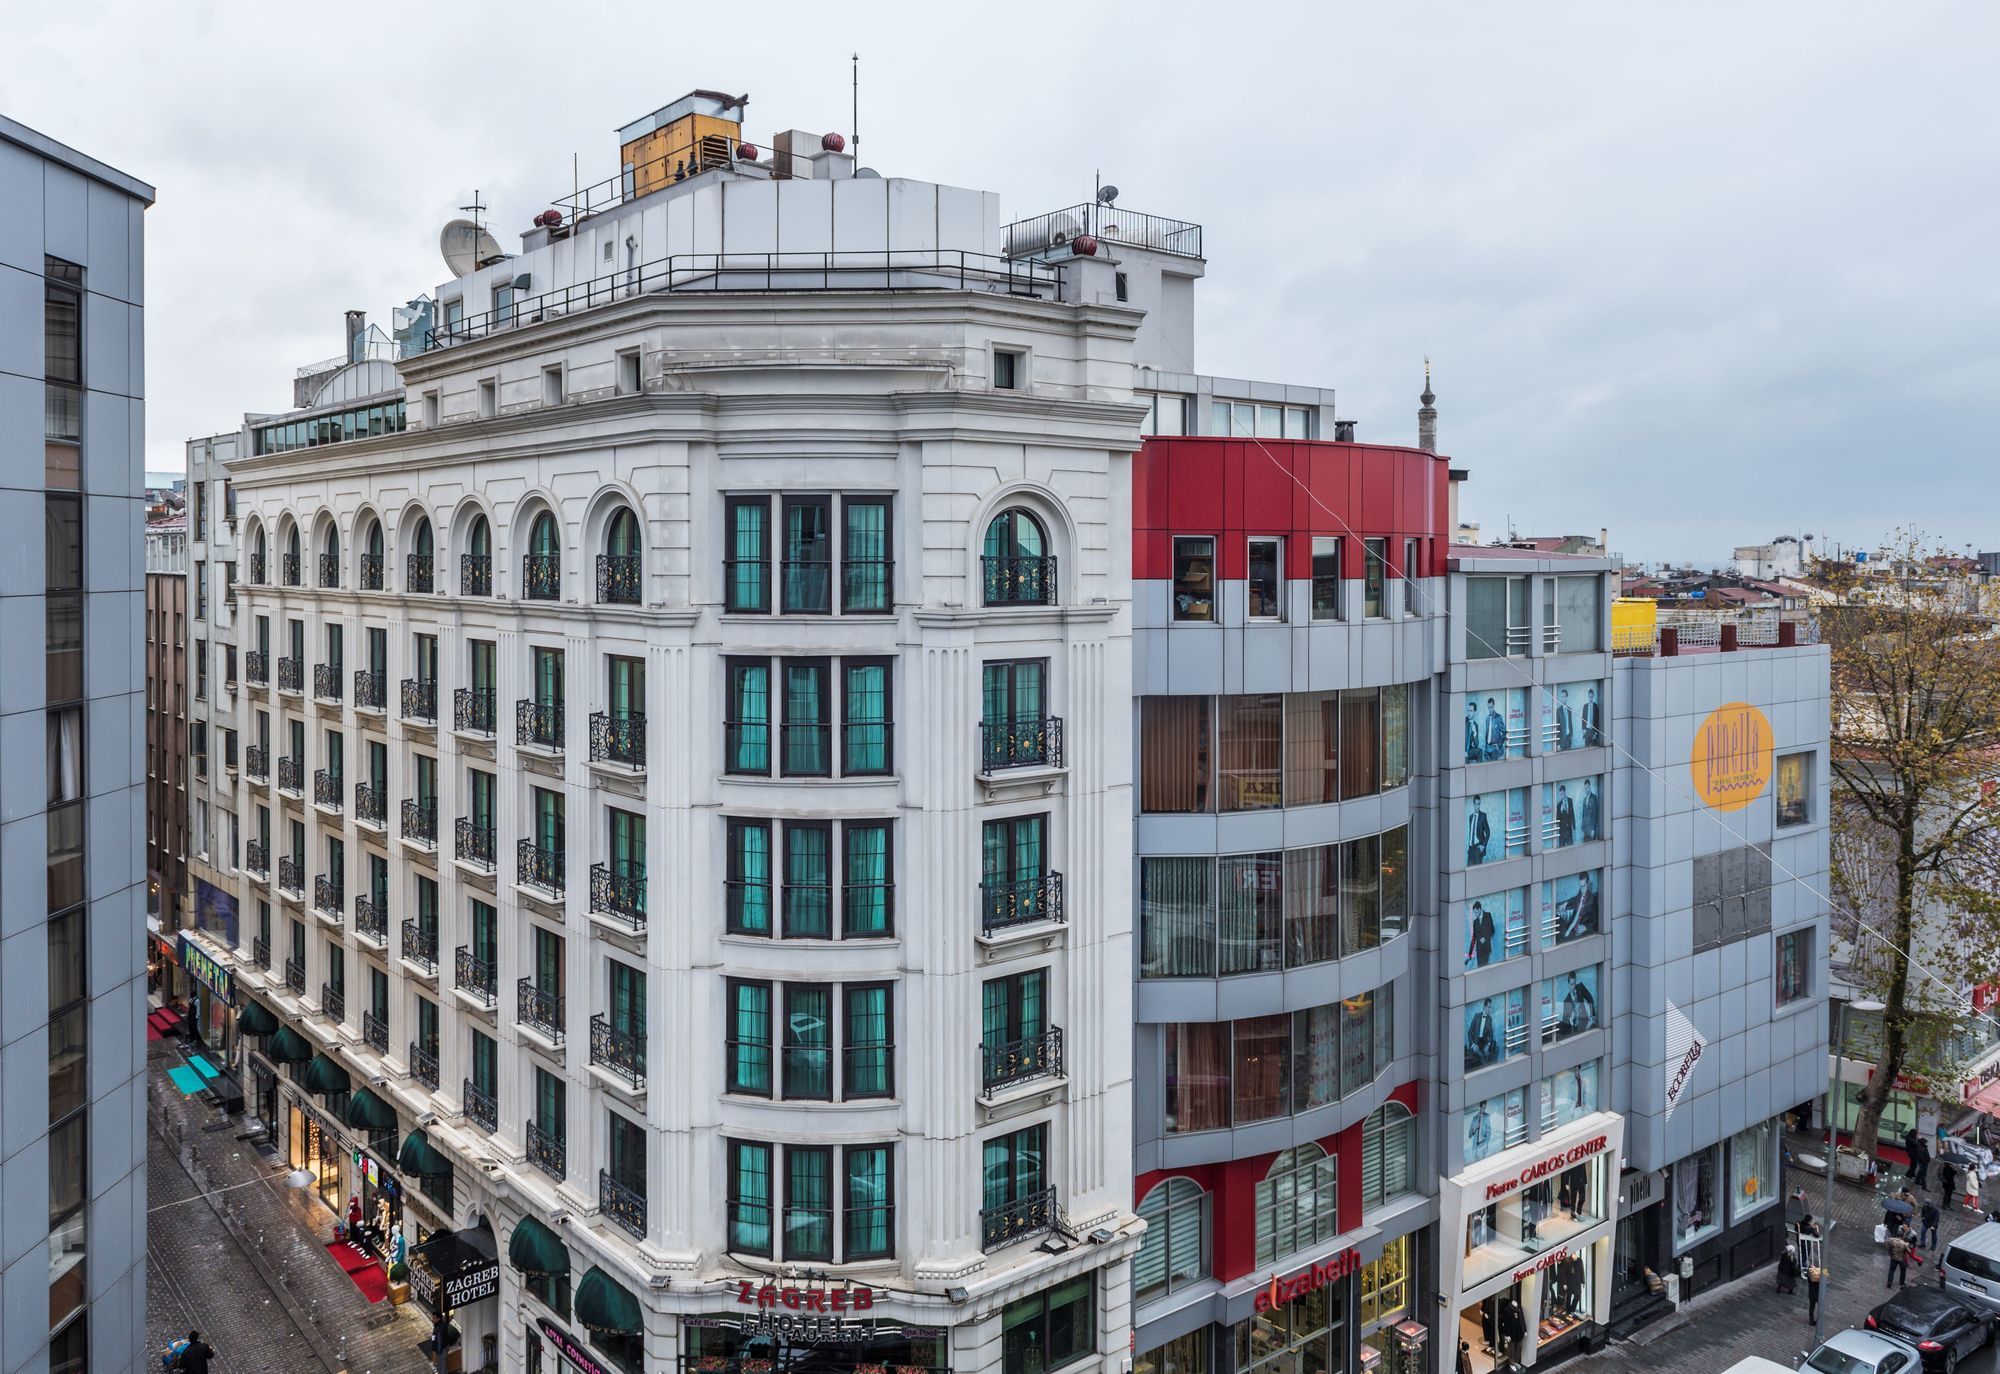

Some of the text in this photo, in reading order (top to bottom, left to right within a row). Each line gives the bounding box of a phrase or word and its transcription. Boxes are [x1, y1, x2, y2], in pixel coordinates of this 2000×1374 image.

[1706, 711, 1759, 796] pinella
[1486, 1135, 1608, 1201] Pierre CARLOS CENTER
[1513, 1246, 1569, 1283] Pierre CARLOS
[446, 1266, 499, 1294] ZAGREB
[450, 1282, 495, 1307] HOTEL
[1254, 1247, 1362, 1314] elizabeth
[737, 1280, 873, 1313] ZAGREB
[703, 1318, 720, 1328] Bar
[740, 1322, 877, 1342] RESTAURANT
[757, 1311, 850, 1335] HOTEL
